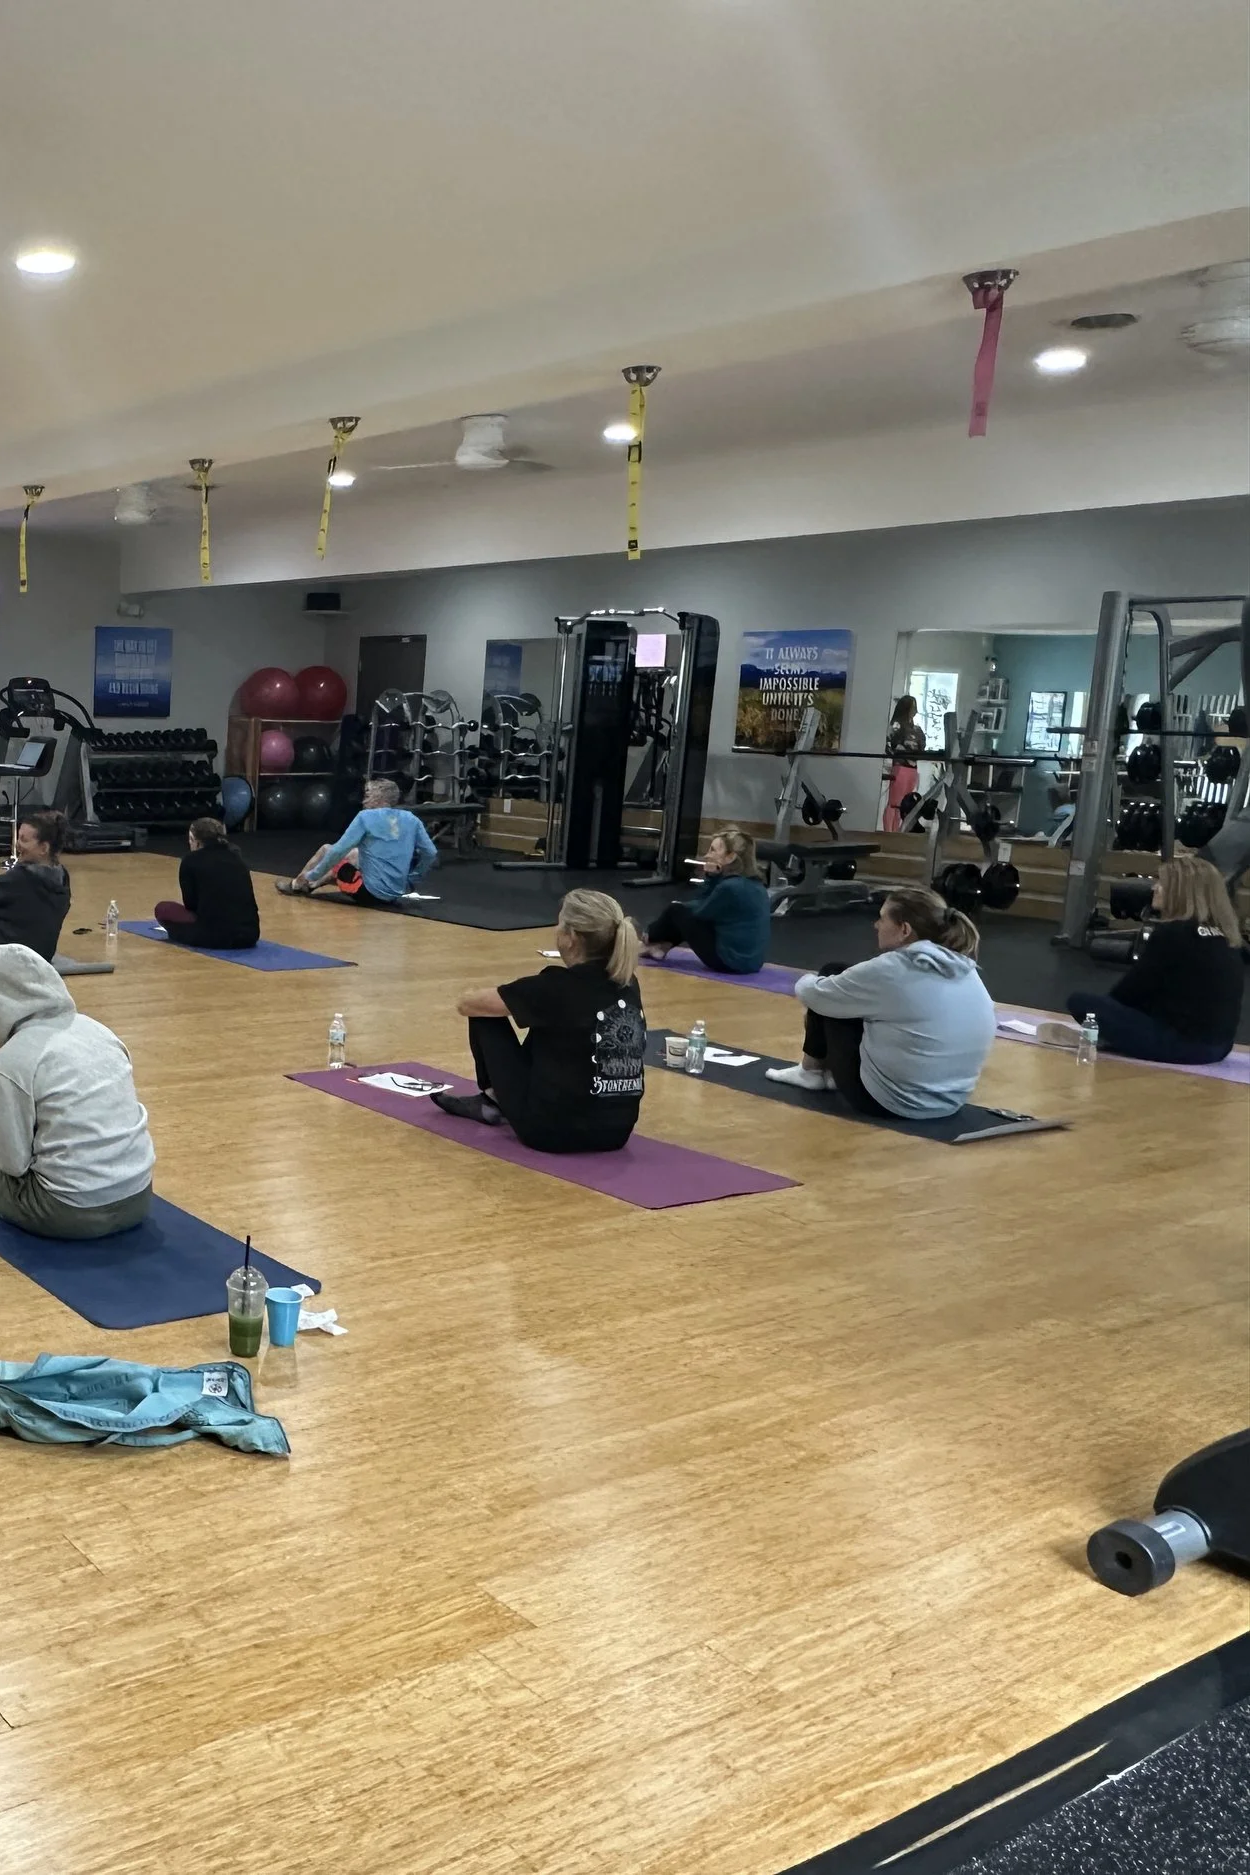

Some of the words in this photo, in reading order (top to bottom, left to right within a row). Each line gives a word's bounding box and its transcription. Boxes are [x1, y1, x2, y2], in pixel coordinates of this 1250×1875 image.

[766, 647, 774, 660] IT
[778, 646, 819, 661] ALWAYS
[774, 662, 807, 675] SEEMS
[759, 677, 820, 691] IMPOSSIBLE
[762, 692, 791, 706] UNTIL
[793, 692, 815, 707] IT'S
